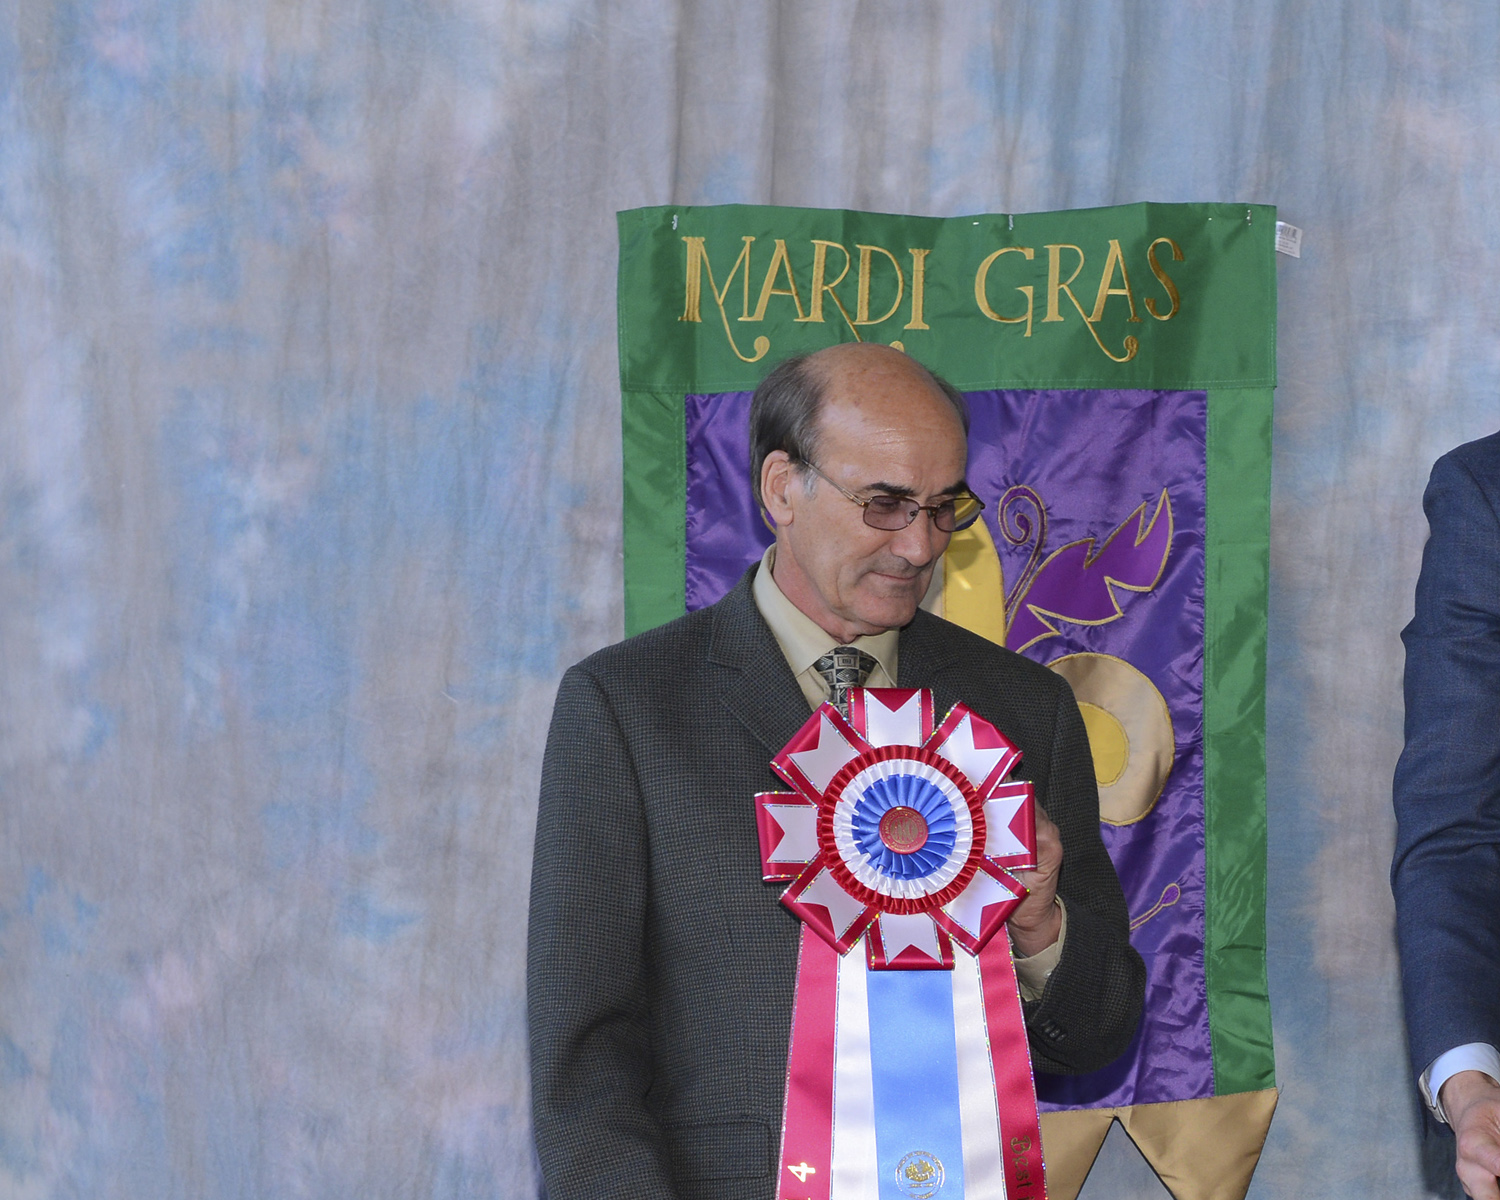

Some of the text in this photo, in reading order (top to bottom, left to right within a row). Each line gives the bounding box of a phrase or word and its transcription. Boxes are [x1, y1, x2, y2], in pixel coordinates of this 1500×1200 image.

[677, 235, 1186, 363] MARDI GRAS
[1010, 1135, 1033, 1188] Best
